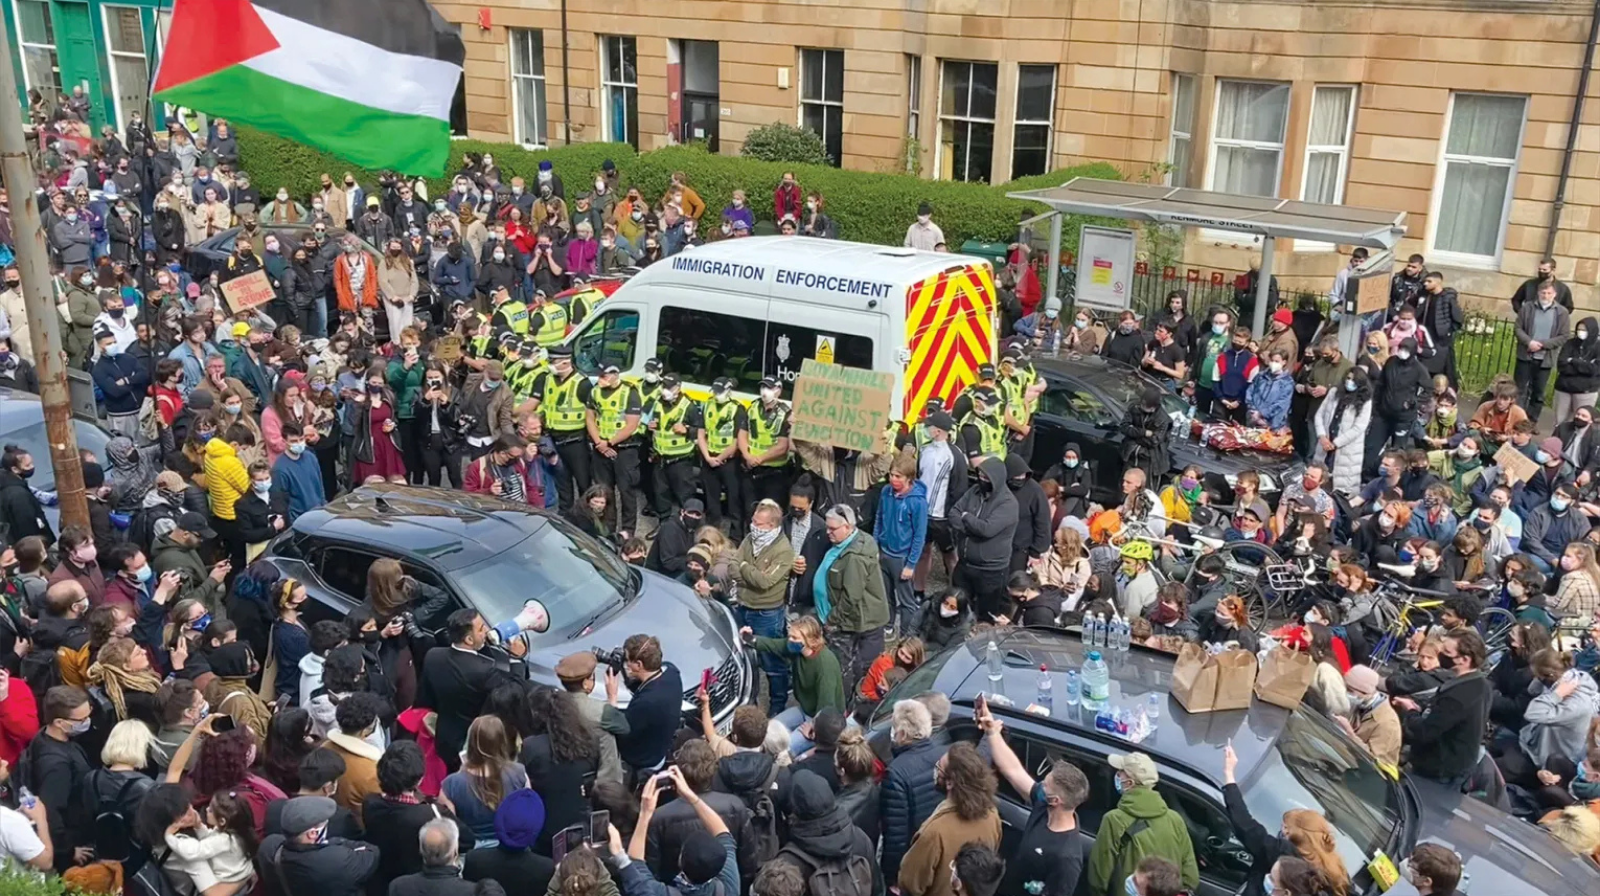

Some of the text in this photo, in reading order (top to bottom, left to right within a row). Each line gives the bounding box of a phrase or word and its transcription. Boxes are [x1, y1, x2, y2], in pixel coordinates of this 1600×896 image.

[671, 256, 893, 299] IMMIGRATION ENFORCEMENT
[802, 380, 863, 405] UNITED
[796, 399, 883, 431] AGAINST
